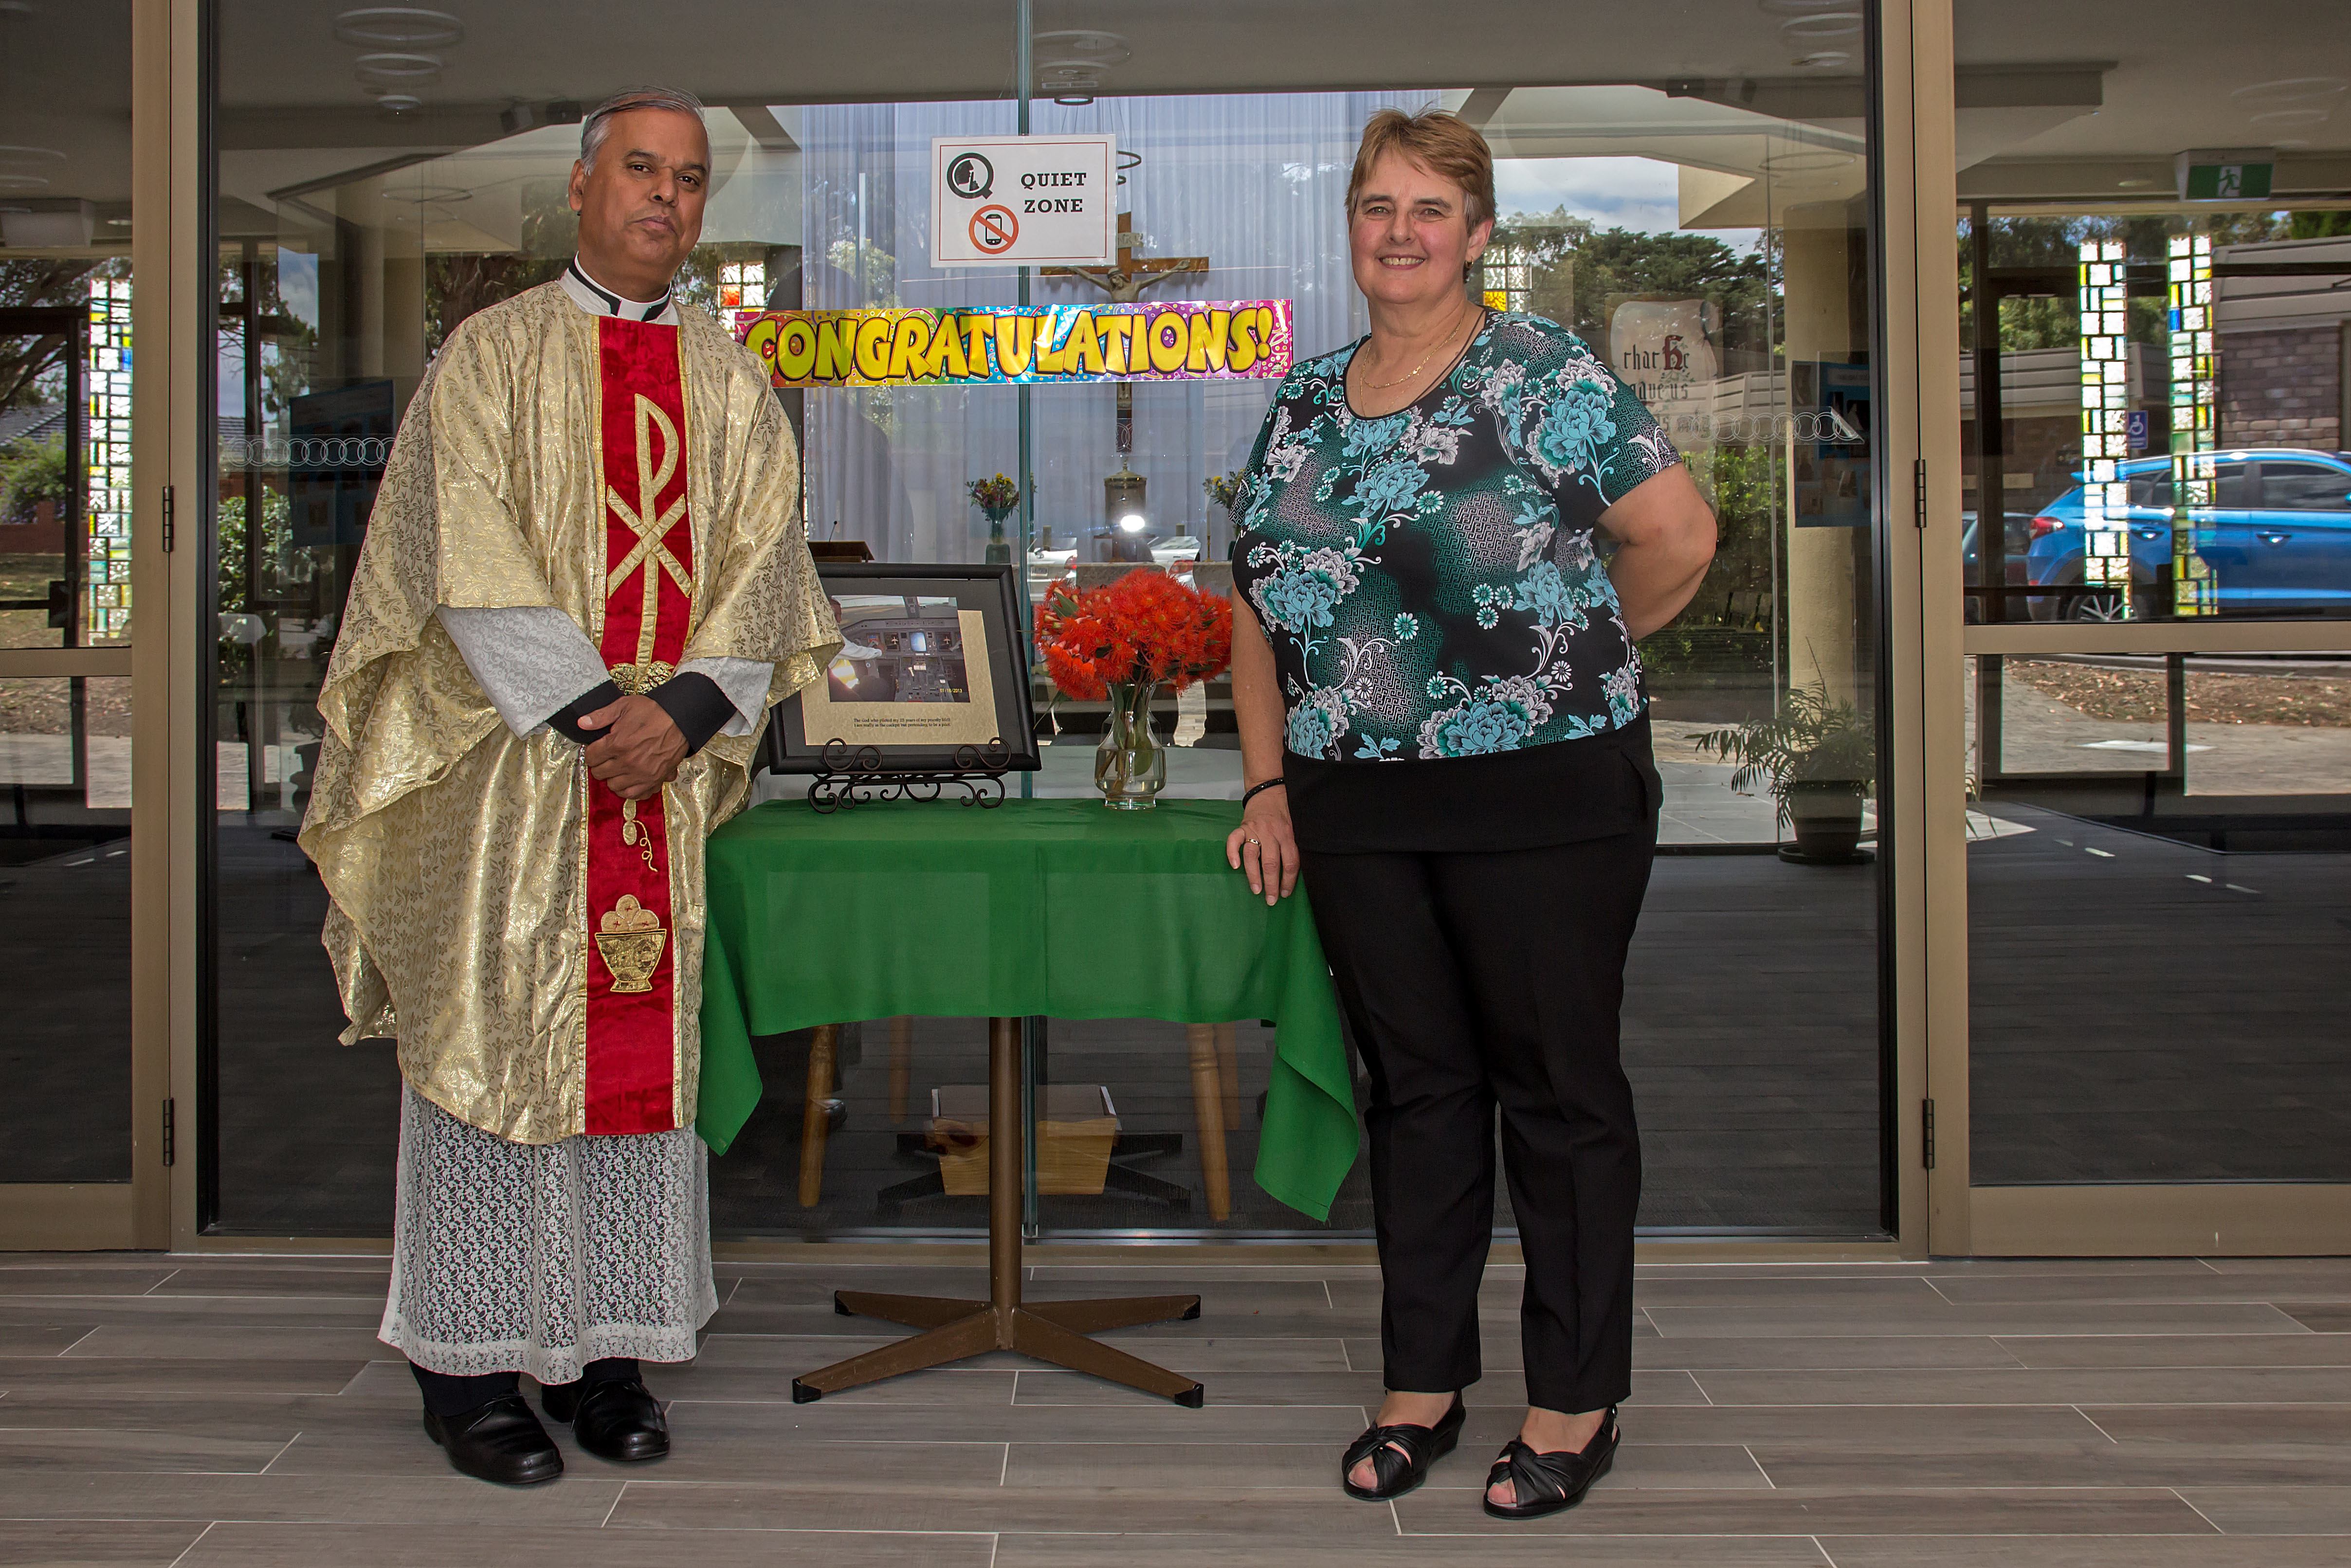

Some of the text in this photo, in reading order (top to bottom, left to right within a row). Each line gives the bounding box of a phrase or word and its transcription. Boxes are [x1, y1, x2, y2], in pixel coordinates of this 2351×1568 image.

[1021, 173, 1087, 190] QUIET
[1024, 199, 1083, 213] ZONE
[744, 306, 1274, 381] CONGRATULATIONS!
